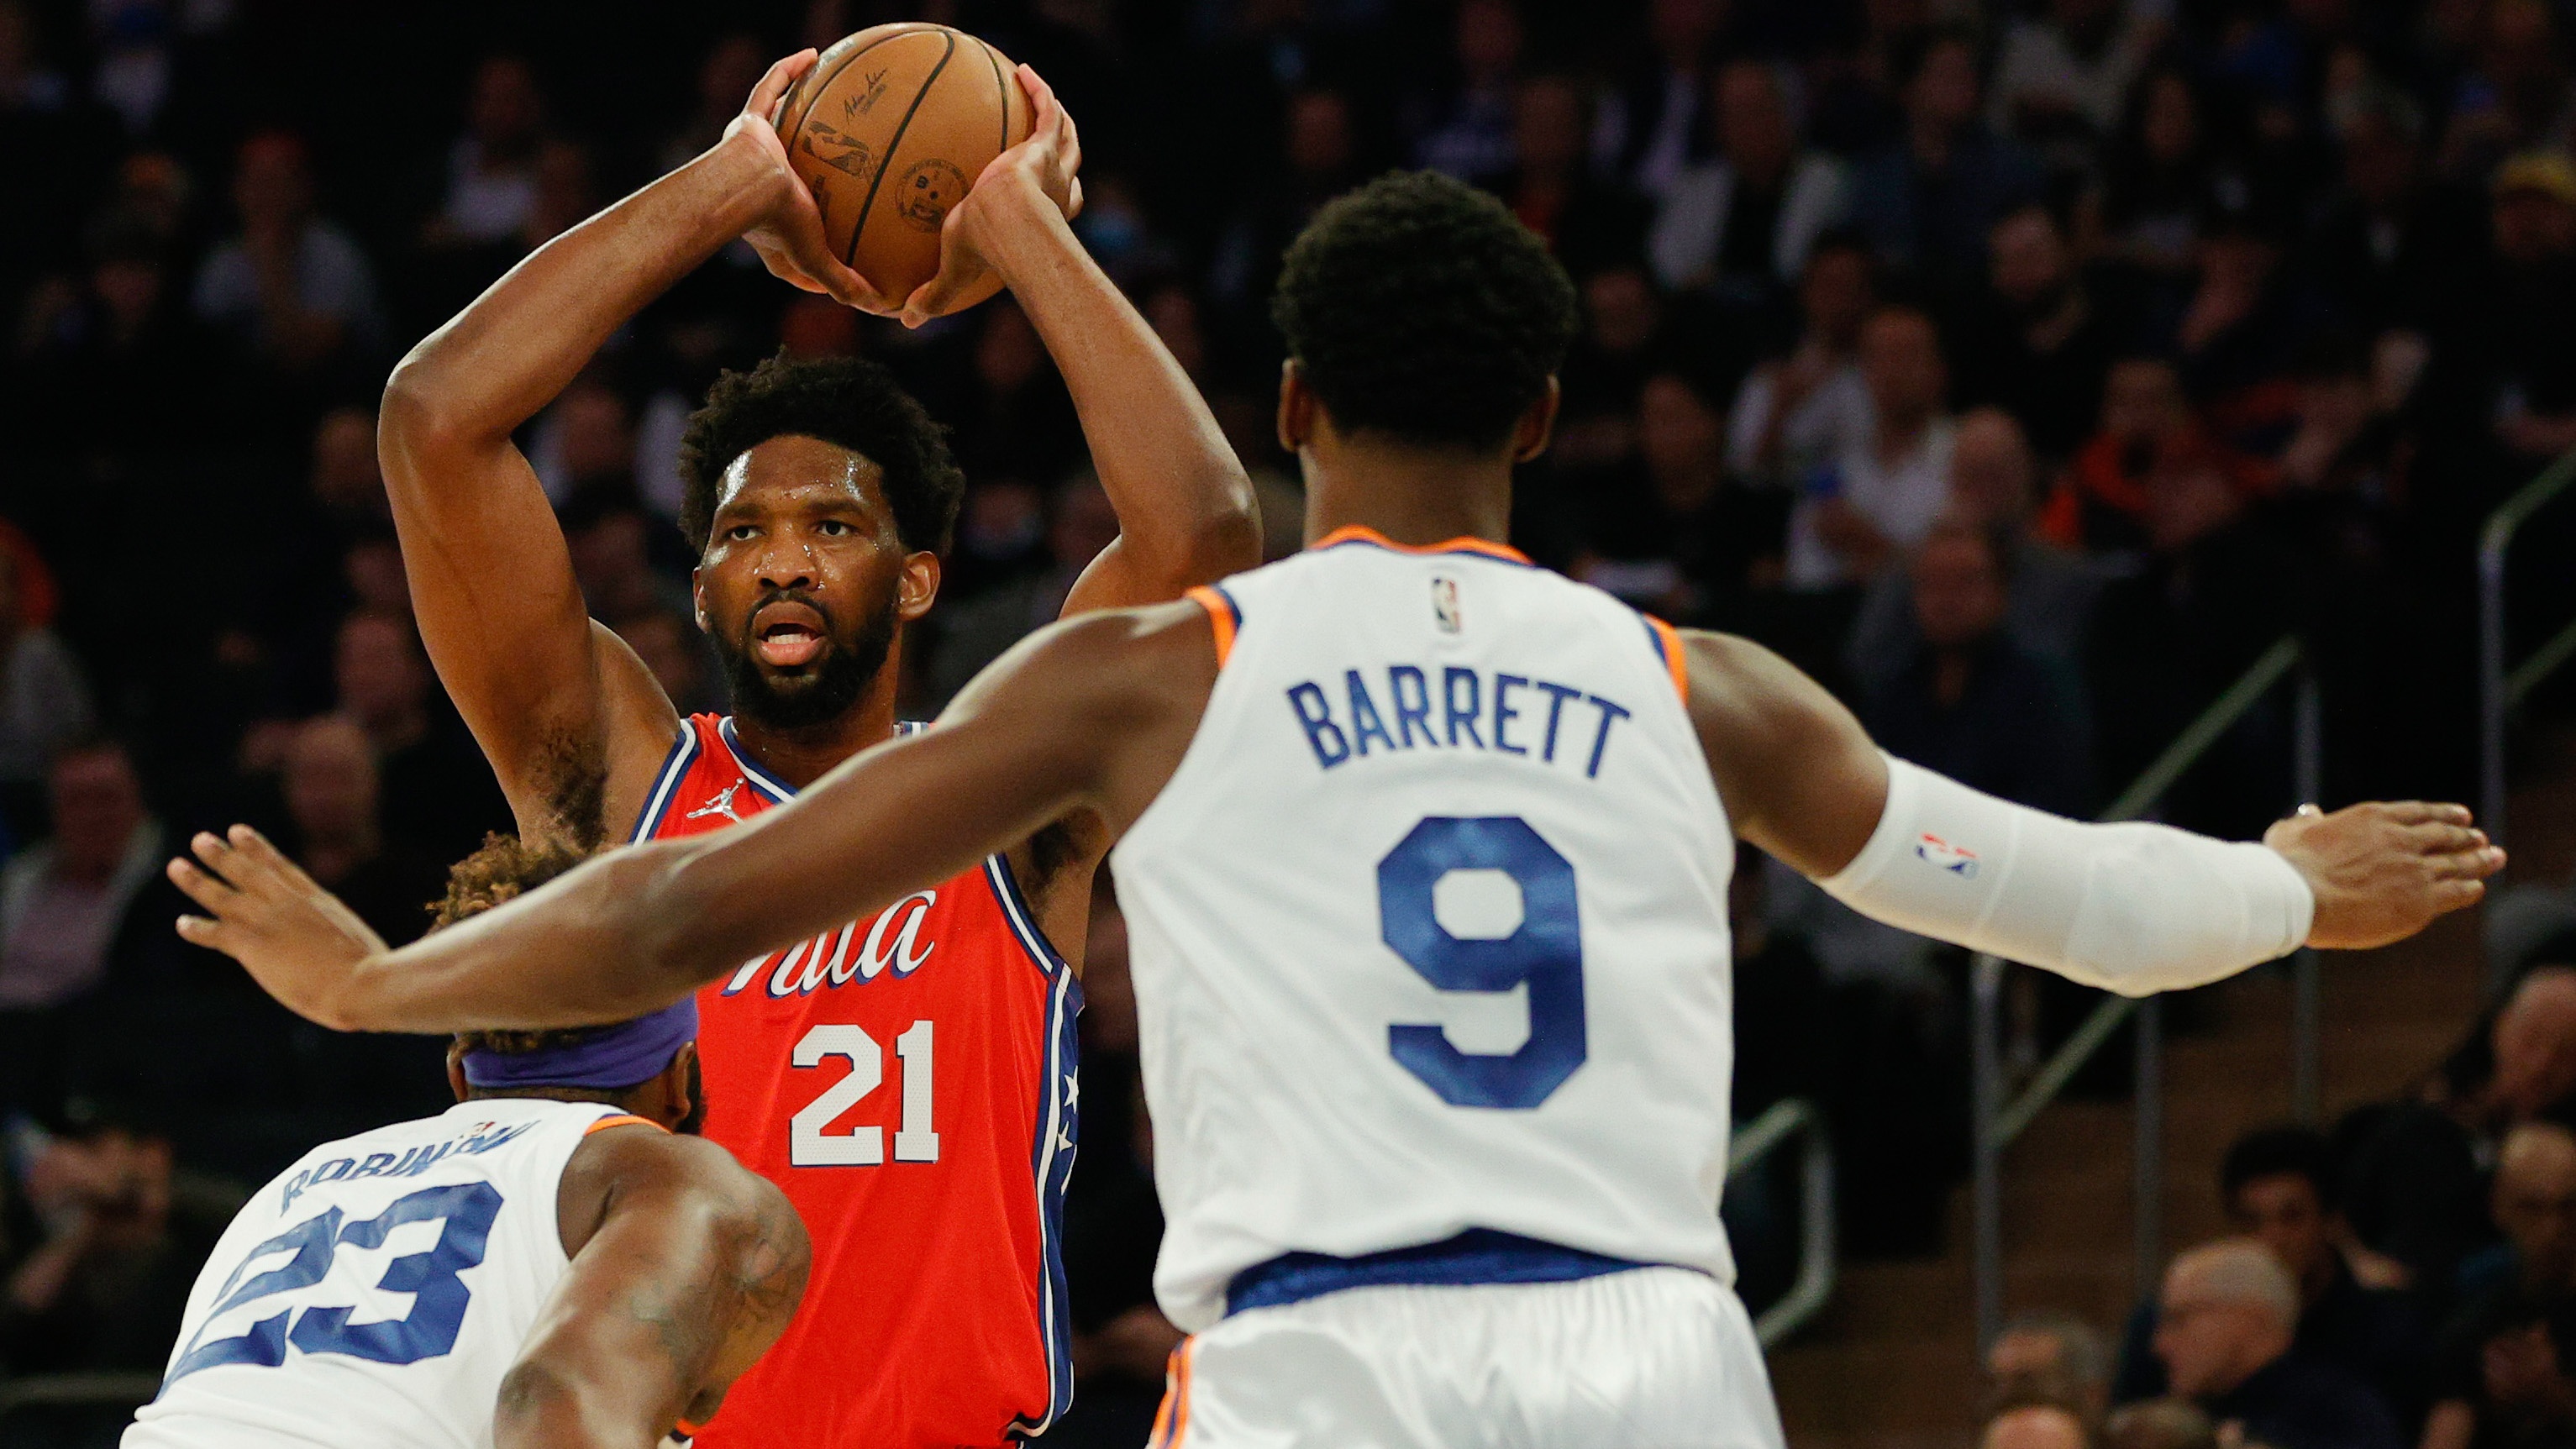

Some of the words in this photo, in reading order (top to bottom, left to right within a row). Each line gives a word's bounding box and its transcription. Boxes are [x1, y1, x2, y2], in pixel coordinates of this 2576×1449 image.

[1286, 665, 1631, 780] BARRETT
[1376, 816, 1588, 1110] 9
[790, 1020, 940, 1167] 21
[280, 1120, 542, 1218] ROBINN
[152, 1179, 505, 1404] 23
